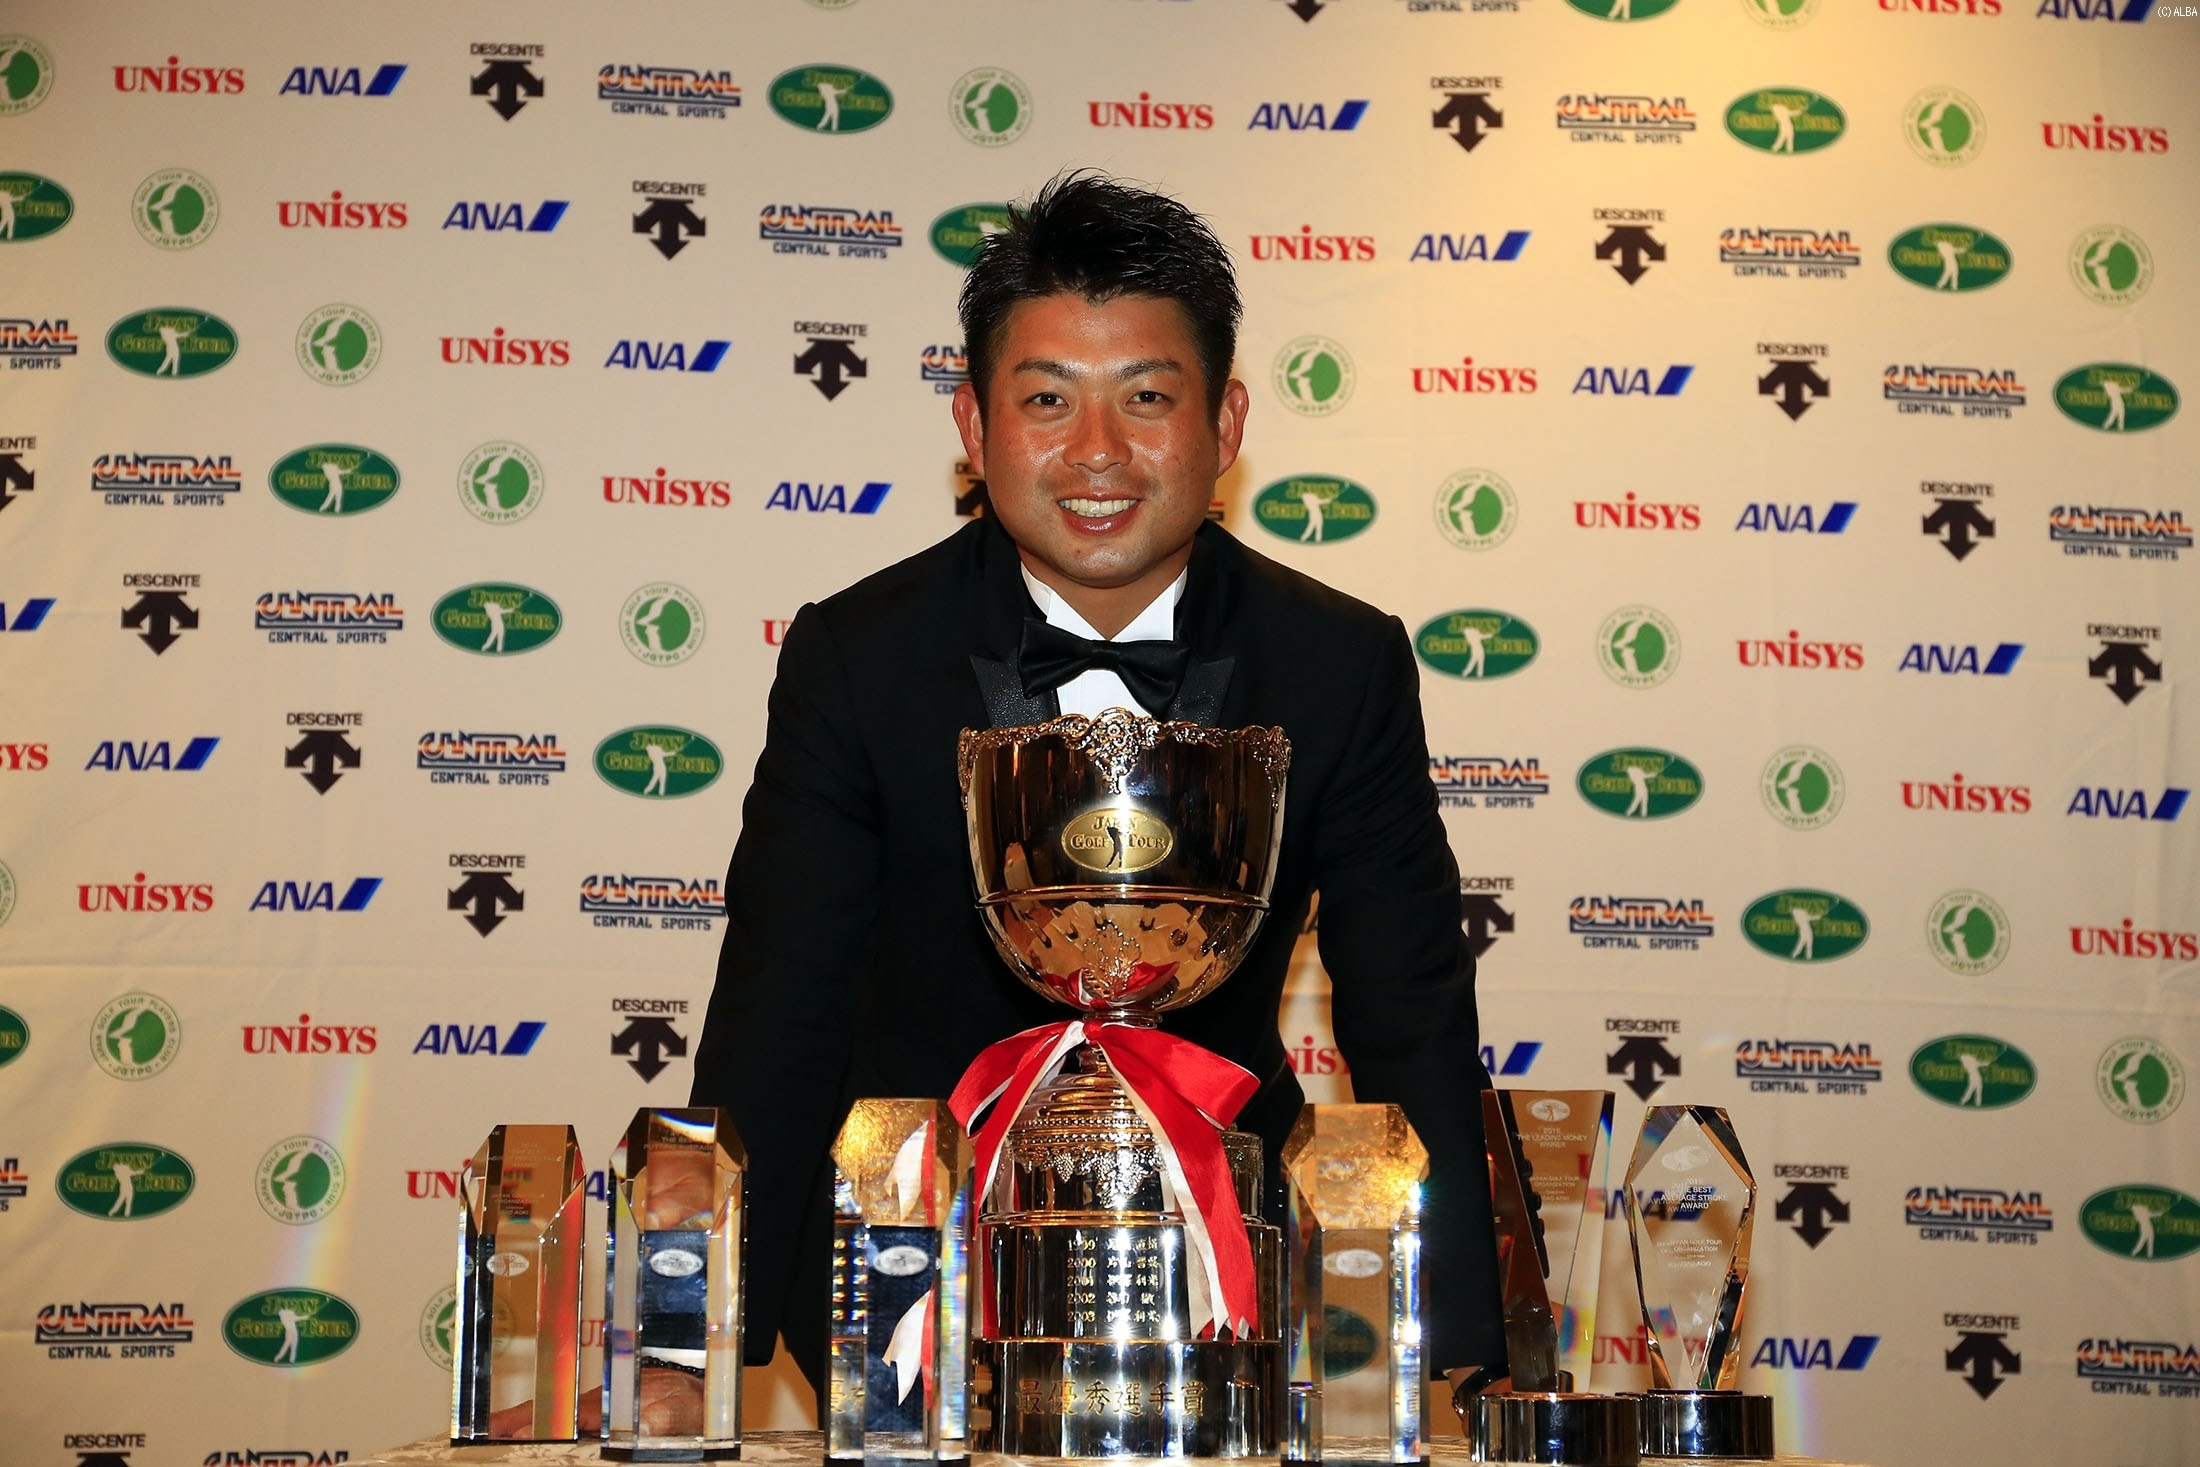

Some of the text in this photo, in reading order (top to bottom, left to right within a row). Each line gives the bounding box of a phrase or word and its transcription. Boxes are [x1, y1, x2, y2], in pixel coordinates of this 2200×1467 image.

[470, 43, 544, 57] DESCENTE
[279, 67, 361, 96] ANA
[1430, 77, 1501, 92] DESCENTE
[612, 103, 728, 119] CENTRAL SPORTS
[1248, 103, 1326, 130] ANA
[632, 181, 706, 196] DESCENTE
[442, 202, 523, 232] ANA
[1593, 208, 1664, 221] DESCENTE
[773, 243, 888, 259] CENTRAL SPORTS
[1410, 234, 1488, 261] ANA
[794, 321, 867, 336] DESCENTE
[605, 340, 685, 371] ANA
[1757, 343, 1828, 357] DESCENTE
[10, 356, 61, 369] SPORTS
[1573, 367, 1651, 396] ANA
[0, 437, 36, 449] ENTE
[1921, 481, 1993, 496] DESCENTE
[105, 492, 224, 506] CENTRAL SPORTS
[766, 482, 846, 513] ANA
[1736, 504, 1815, 533] ANA
[123, 574, 200, 587] DESCENTE
[269, 630, 387, 644] CENTRAL SPORTS
[2087, 624, 2161, 639] DESCENTE
[1899, 644, 1980, 674] ANA
[287, 712, 362, 726] DESCENTE
[85, 741, 170, 771] ANA
[431, 771, 551, 785] CENTRAL SPORTS
[1488, 793, 1536, 806] SPORTS
[2067, 787, 2146, 819] ANA
[1128, 834, 1166, 849] TOUR
[449, 854, 525, 868] DESCENTE
[1460, 877, 1514, 890] SCENTE
[249, 881, 333, 911] ANA
[593, 915, 713, 931] CENTRAL SPORTS
[1583, 936, 1699, 950] CENTRAL SPORTS
[612, 999, 688, 1014] DESCENTE
[1605, 1018, 1680, 1033] DESCENTE
[413, 1024, 497, 1055] ANA
[1750, 1080, 1867, 1095] CENTRAL SPORTS
[1774, 1164, 1849, 1179] DESCENTE
[1067, 1257, 1097, 1269] 2000
[1067, 1293, 1096, 1304] 2002
[1067, 1310, 1096, 1322] 2003
[1944, 1313, 2020, 1328] DESCENTE
[48, 1344, 175, 1359] CENTRAL SPORTS
[1750, 1338, 1833, 1370] ANA
[1016, 1378, 1206, 1416] 最優秀選手賞
[64, 1434, 146, 1449] DESCENTE
